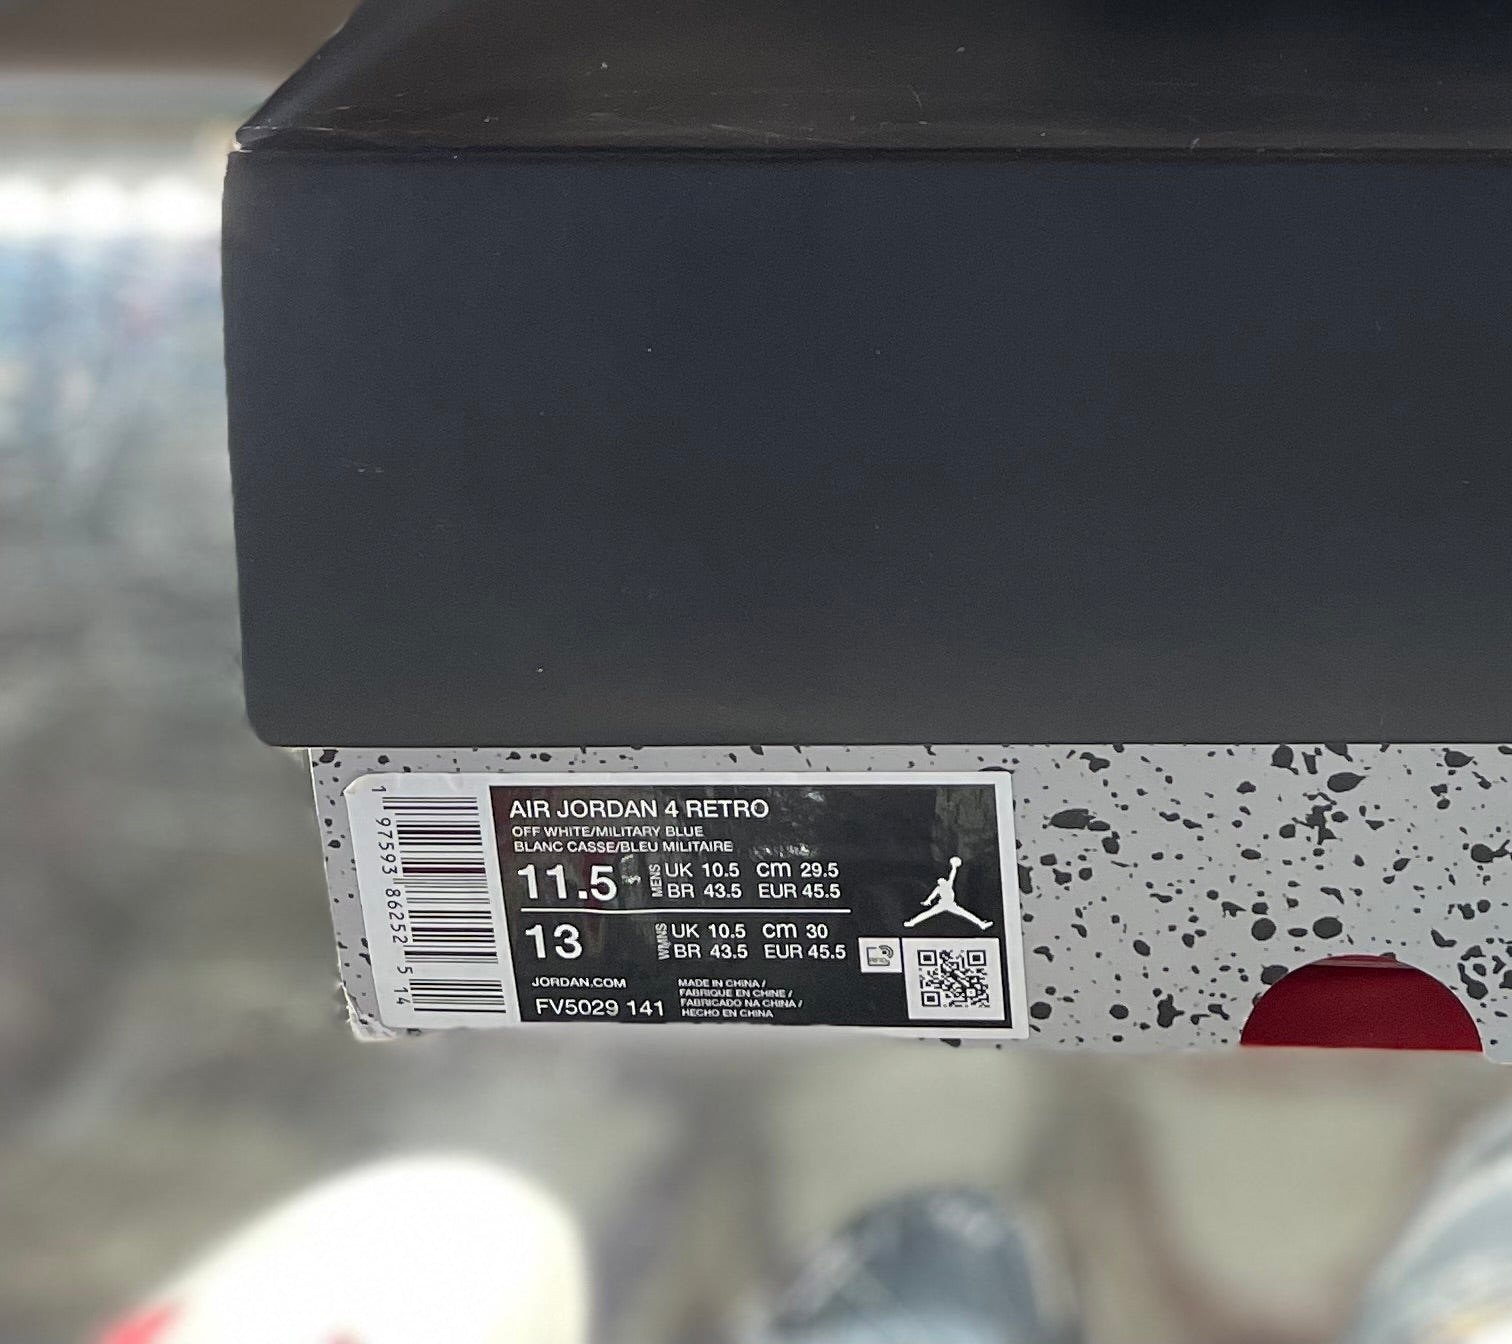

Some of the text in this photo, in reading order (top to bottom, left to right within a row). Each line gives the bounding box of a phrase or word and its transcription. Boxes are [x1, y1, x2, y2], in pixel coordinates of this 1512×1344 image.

[509, 798, 770, 819] AIR JORDAN 4 RETRO
[511, 825, 704, 838] OFF WHITE/MILITARY BLUE
[375, 817, 399, 875] 97593
[513, 840, 734, 853] BLANC CASSE/BLEU MILITAIRE
[664, 862, 694, 878] UK
[701, 862, 741, 878] 10.5
[800, 862, 840, 878] 29.5
[517, 863, 618, 902] 11.5
[648, 863, 664, 898] MENS
[667, 883, 841, 899] BR 43.5 EUR 45.5
[385, 887, 409, 945] 86252
[671, 923, 701, 939] UK
[707, 923, 747, 939] 10.5
[805, 923, 829, 939] 30
[524, 923, 583, 960] 13
[673, 943, 847, 959] BR 43.5 EUR 45.5
[531, 976, 627, 989] JORDAN.COM
[677, 978, 710, 988] MADE
[712, 979, 724, 987] IN
[725, 979, 760, 988] CHINA
[393, 986, 412, 1005] 14
[679, 989, 733, 998] FABRIQUE
[735, 990, 751, 998] EN
[752, 989, 787, 998] CHINE
[534, 998, 664, 1017] FV5029 141
[680, 999, 743, 1008] FABRICADO
[744, 999, 761, 1008] NA
[762, 999, 797, 1008] CHINA
[681, 1008, 774, 1018] HECHO EN CHINA
